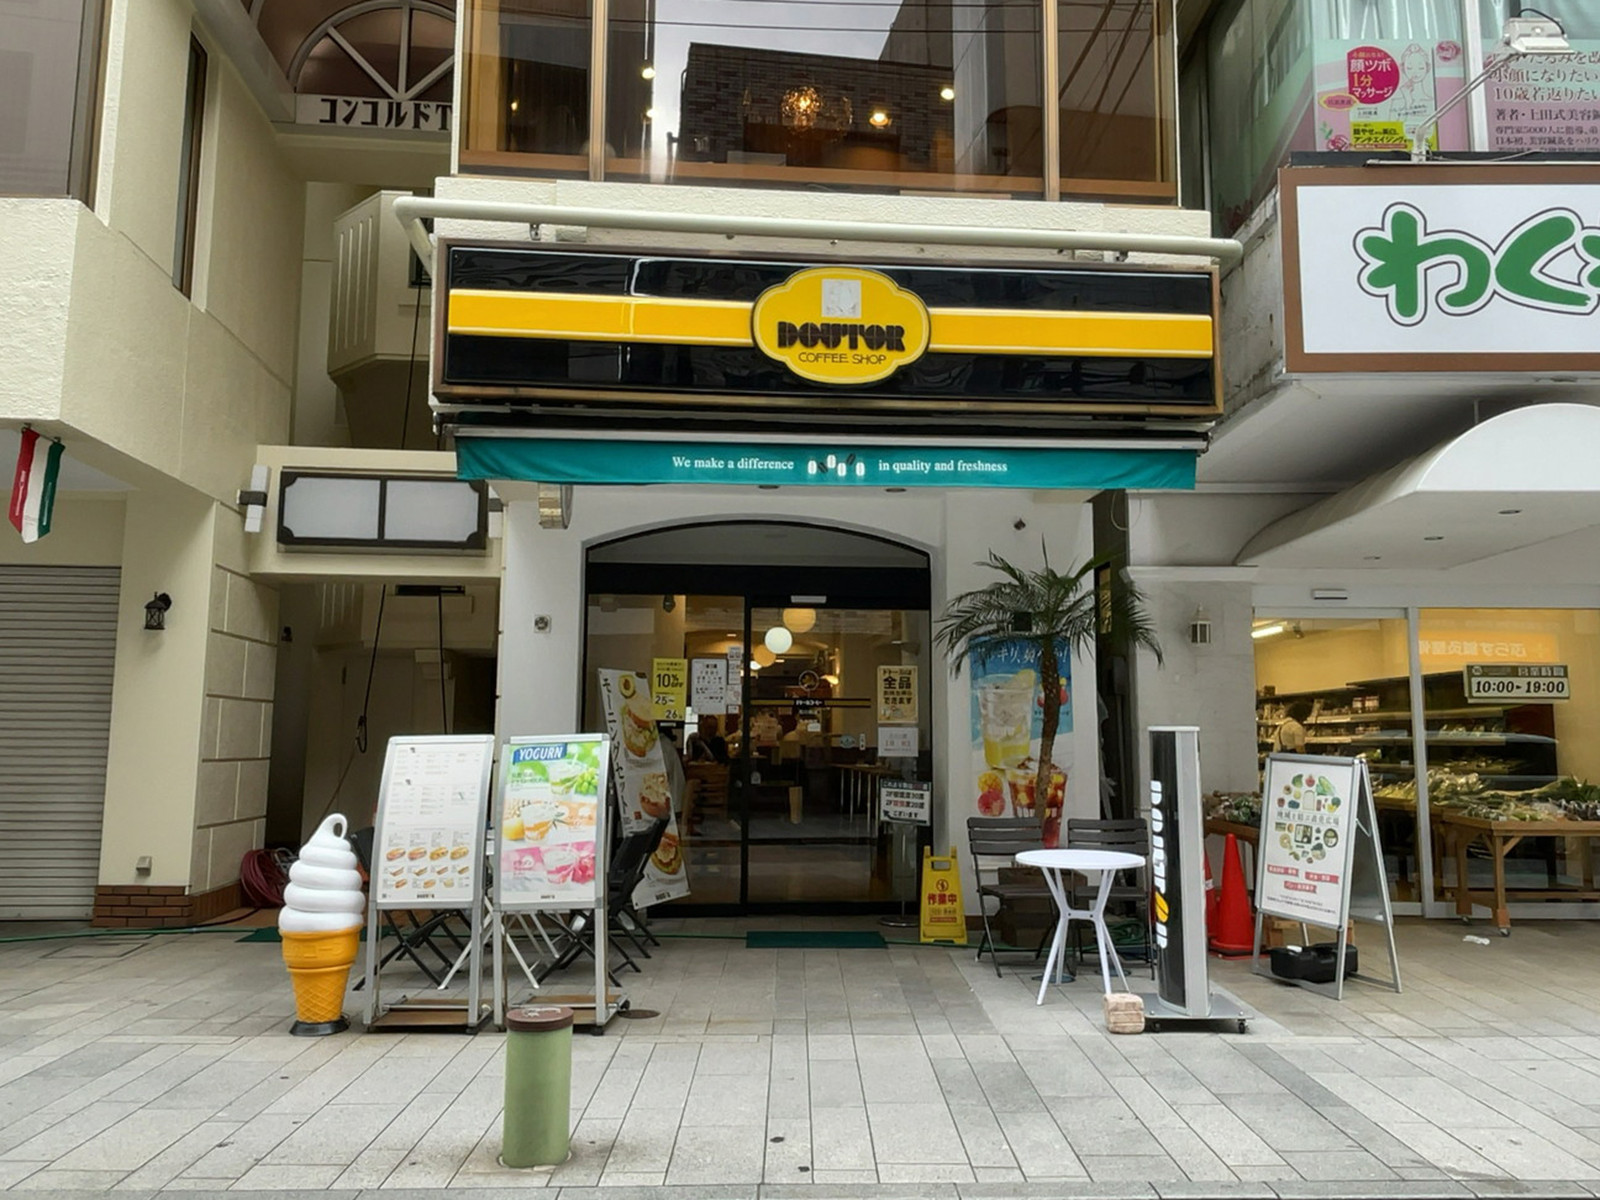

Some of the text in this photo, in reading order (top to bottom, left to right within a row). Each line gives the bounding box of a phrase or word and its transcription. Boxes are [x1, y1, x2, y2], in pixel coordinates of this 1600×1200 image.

[1350, 58, 1392, 72] 顔ツボ
[1353, 73, 1373, 87] 1分
[1352, 86, 1392, 98] マッサージ
[1354, 202, 1600, 326] わく
[778, 321, 905, 351] DOUTOR
[798, 352, 887, 365] COFFEE SHOP
[672, 456, 1008, 474] We make a difference in quality and freshness
[883, 675, 912, 690] 全品
[1475, 681, 1566, 694] 10:00 19:00
[601, 677, 628, 814] モーニングセット
[519, 746, 564, 761] YOGURN
[926, 892, 958, 906] 作業中
